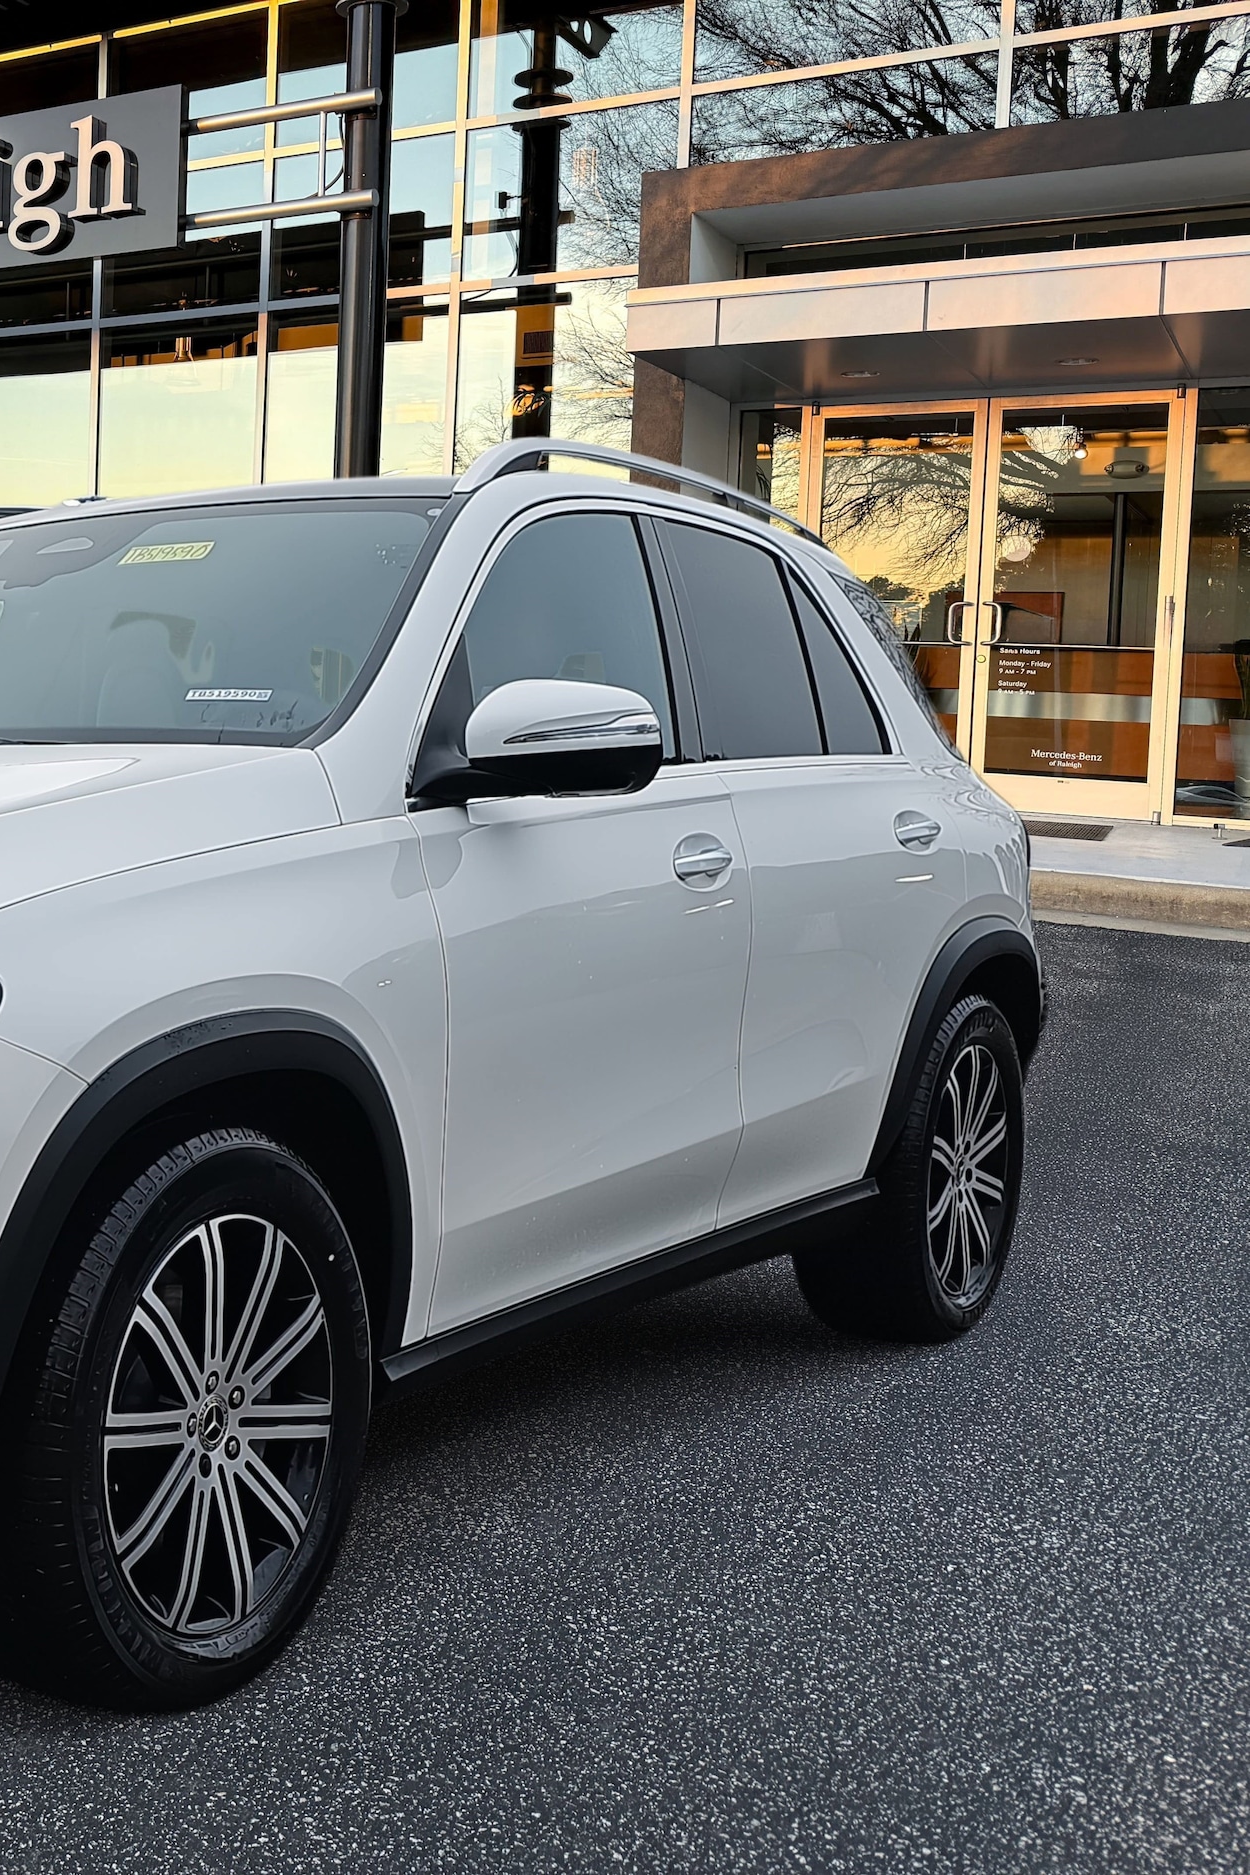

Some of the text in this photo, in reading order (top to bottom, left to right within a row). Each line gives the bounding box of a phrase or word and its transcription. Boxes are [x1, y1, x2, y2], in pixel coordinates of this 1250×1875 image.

[999, 660, 1025, 668] Monday
[1031, 661, 1051, 669] Friday
[998, 680, 1027, 688] Saturday
[1030, 749, 1103, 762] Mercedes-Benz
